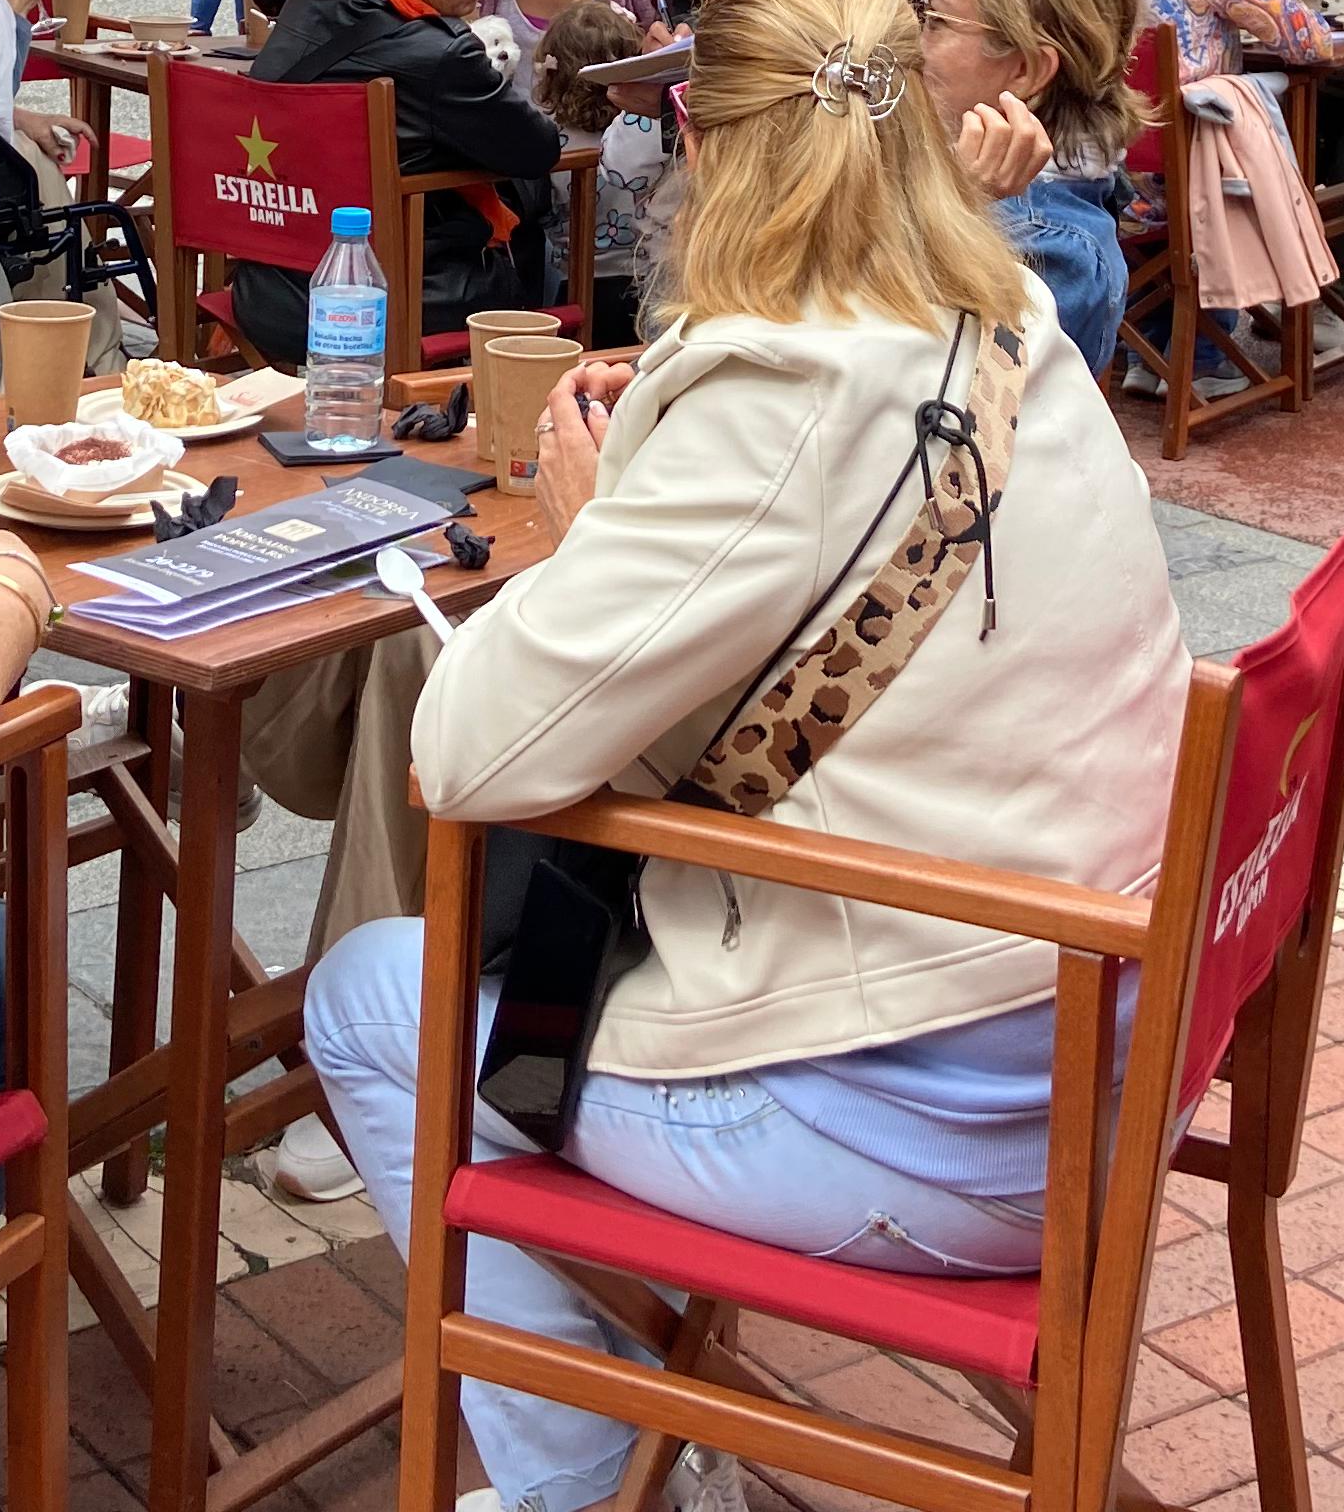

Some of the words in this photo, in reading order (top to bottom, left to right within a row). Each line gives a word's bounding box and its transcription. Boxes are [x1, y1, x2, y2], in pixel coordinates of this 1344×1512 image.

[213, 172, 320, 215] ESTRELLA
[249, 206, 285, 227] DAMM
[336, 487, 420, 521] ANDORRA
[341, 495, 393, 517] TASTE
